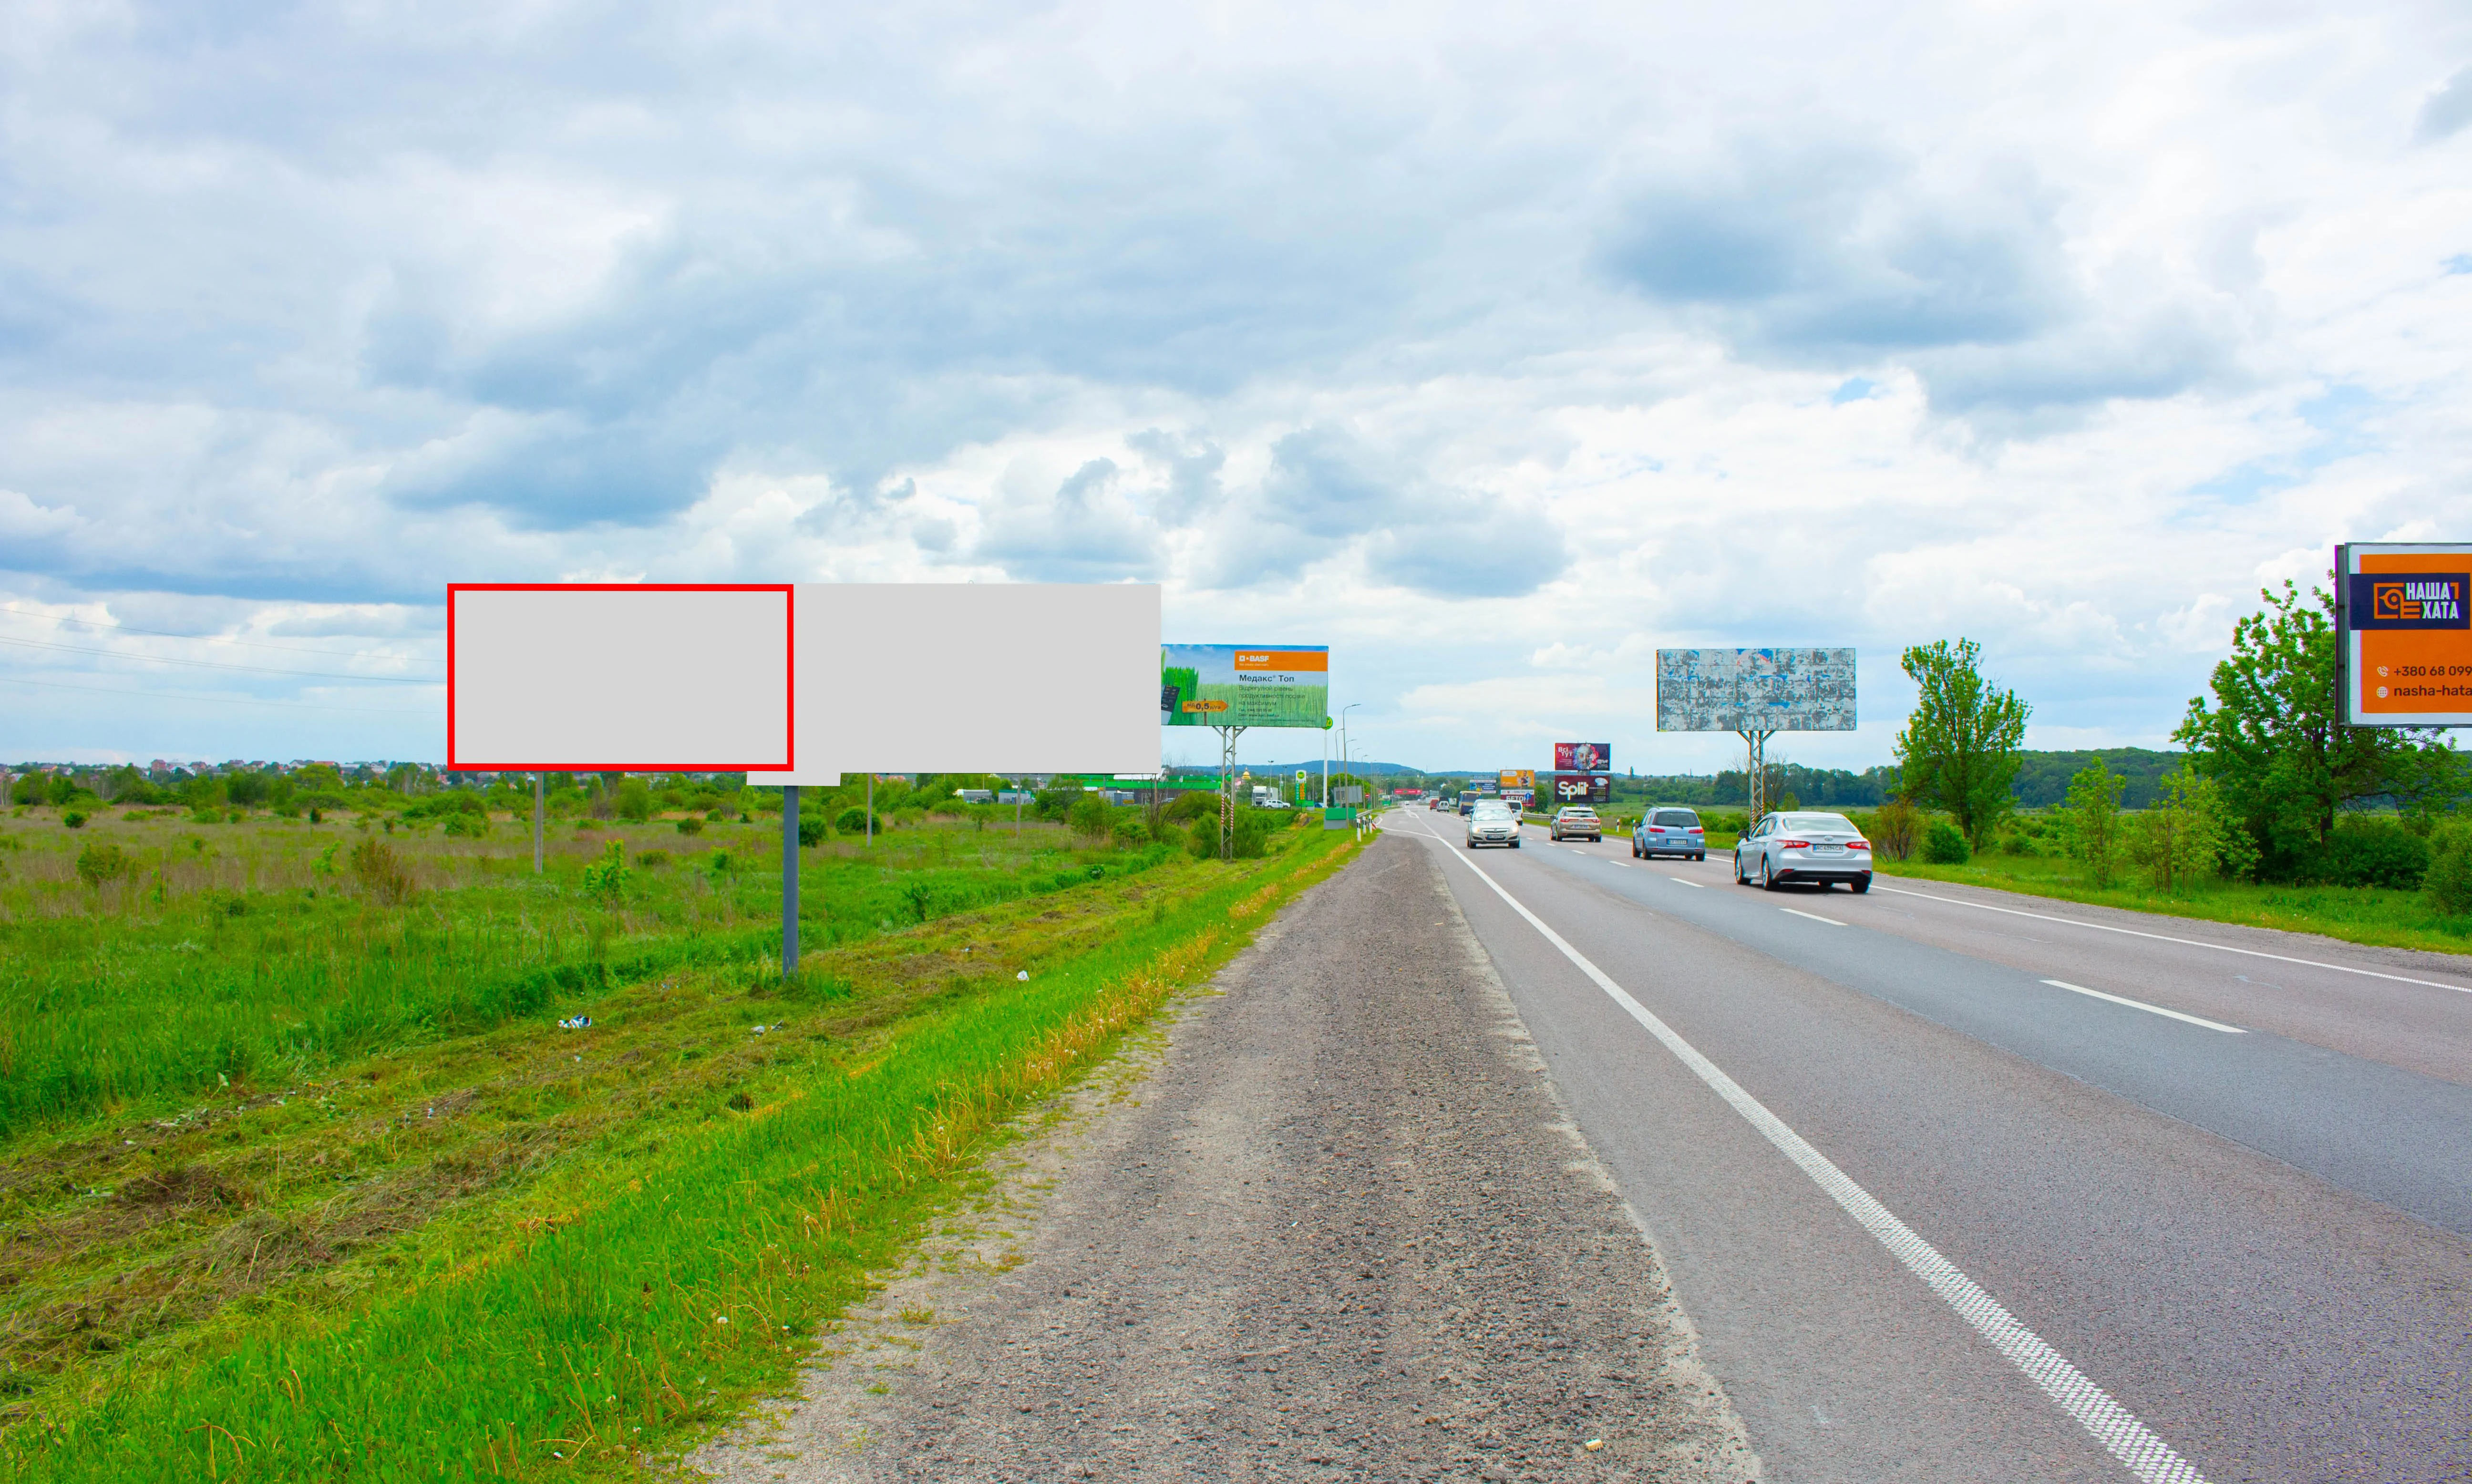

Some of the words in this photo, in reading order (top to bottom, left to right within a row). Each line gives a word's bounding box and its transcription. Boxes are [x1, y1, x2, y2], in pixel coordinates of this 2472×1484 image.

[2406, 582, 2451, 600] НАША
[2422, 601, 2459, 618] ХАТА
[2394, 666, 2426, 676] +380
[2430, 666, 2445, 676] 68
[2449, 666, 2472, 676] 099
[2394, 685, 2472, 696] nasha-hata
[1195, 703, 1210, 711] 0,5
[1558, 781, 1589, 801] Split
